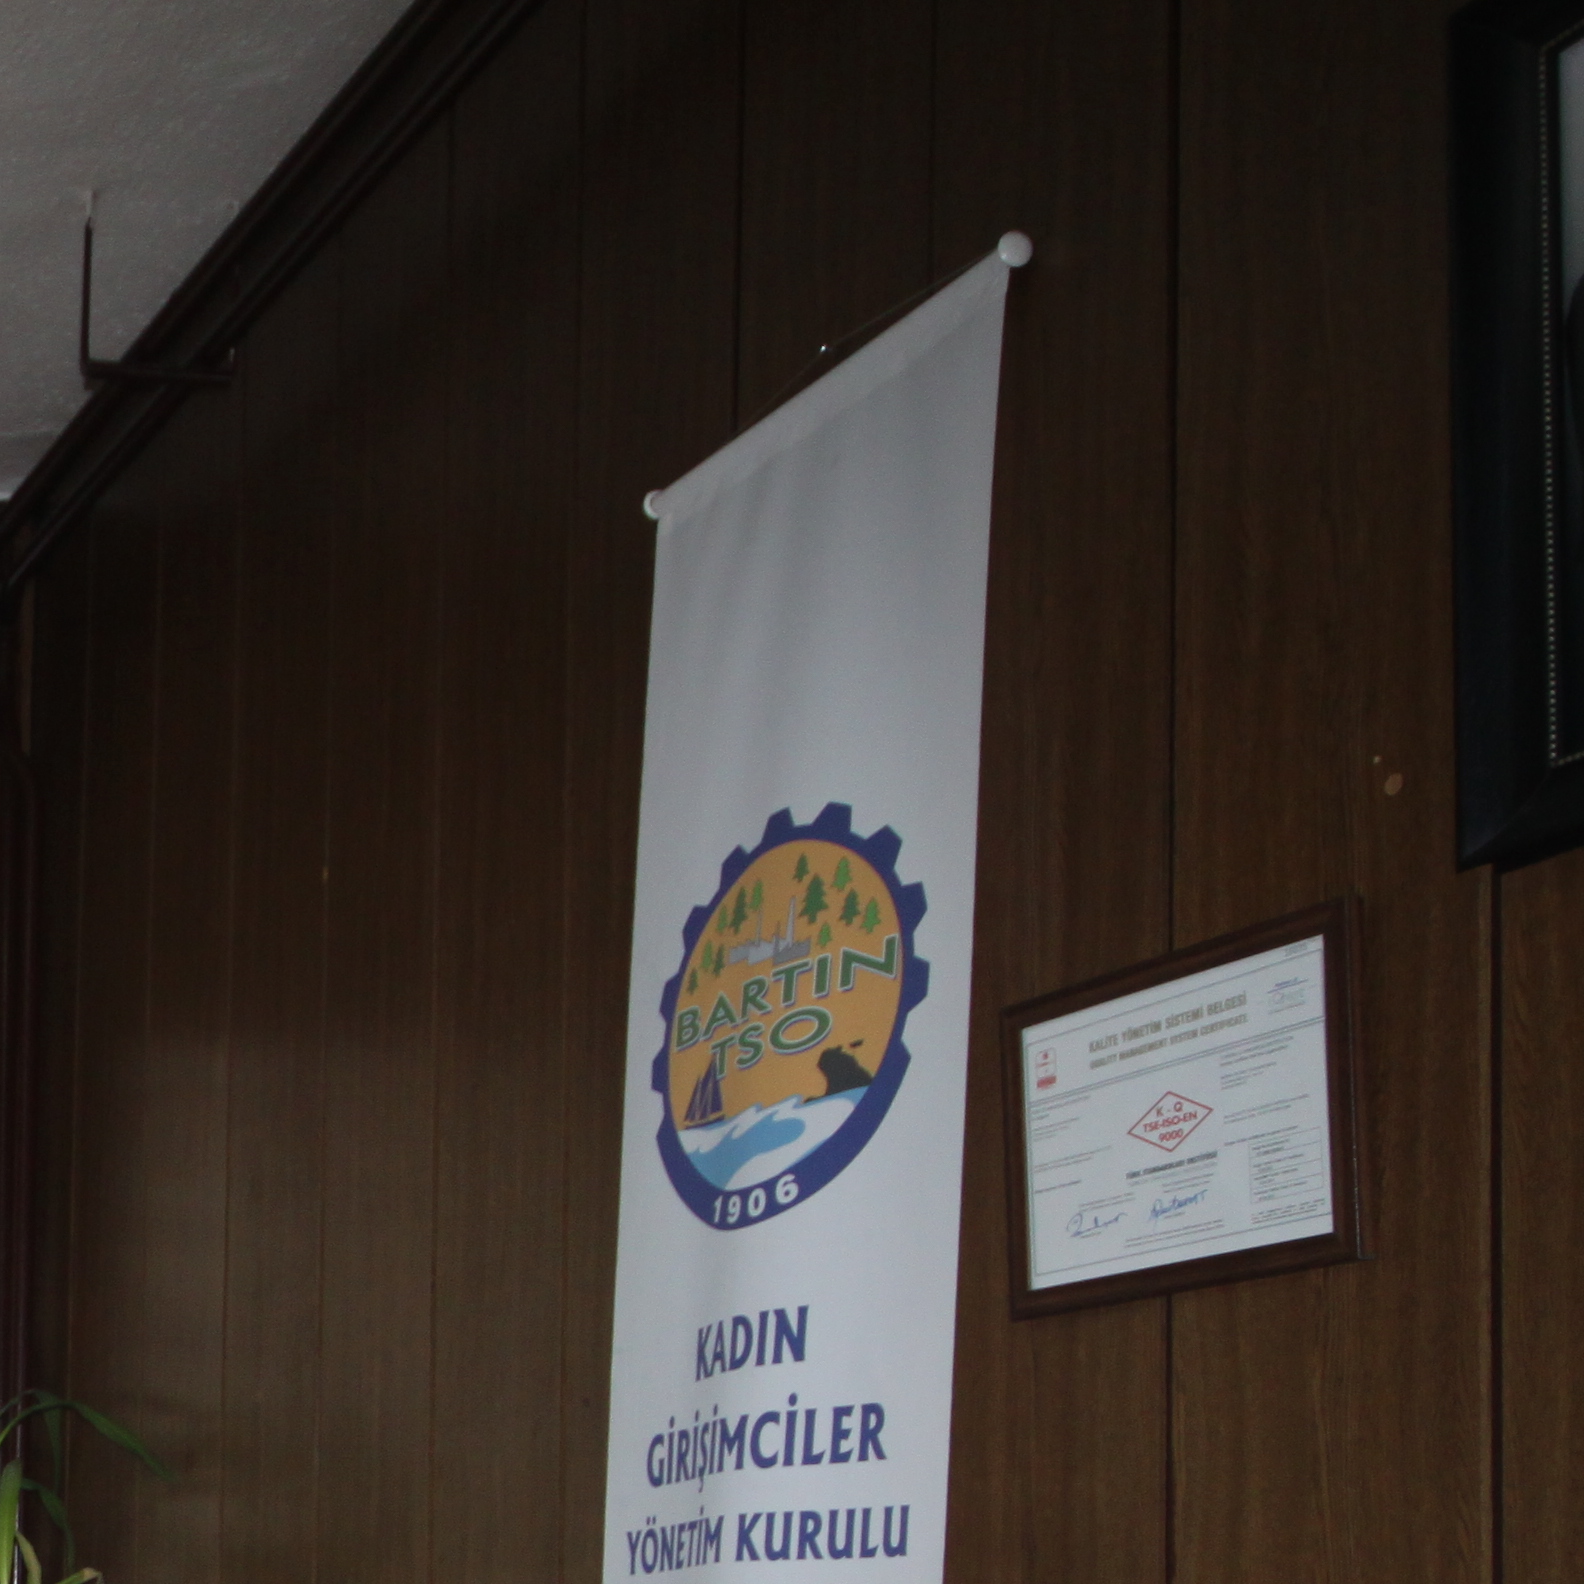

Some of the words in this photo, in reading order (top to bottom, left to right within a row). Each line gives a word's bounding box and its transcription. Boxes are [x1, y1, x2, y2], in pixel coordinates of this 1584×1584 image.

[676, 933, 900, 1052] BARTIN
[710, 1005, 832, 1080] TSO
[713, 1174, 800, 1226] 1906
[695, 1304, 810, 1382] KADIN
[646, 1392, 888, 1493] GİRİŞİMCİLER
[626, 1505, 725, 1576] YÖNETİM
[735, 1504, 911, 1562] KURULU
